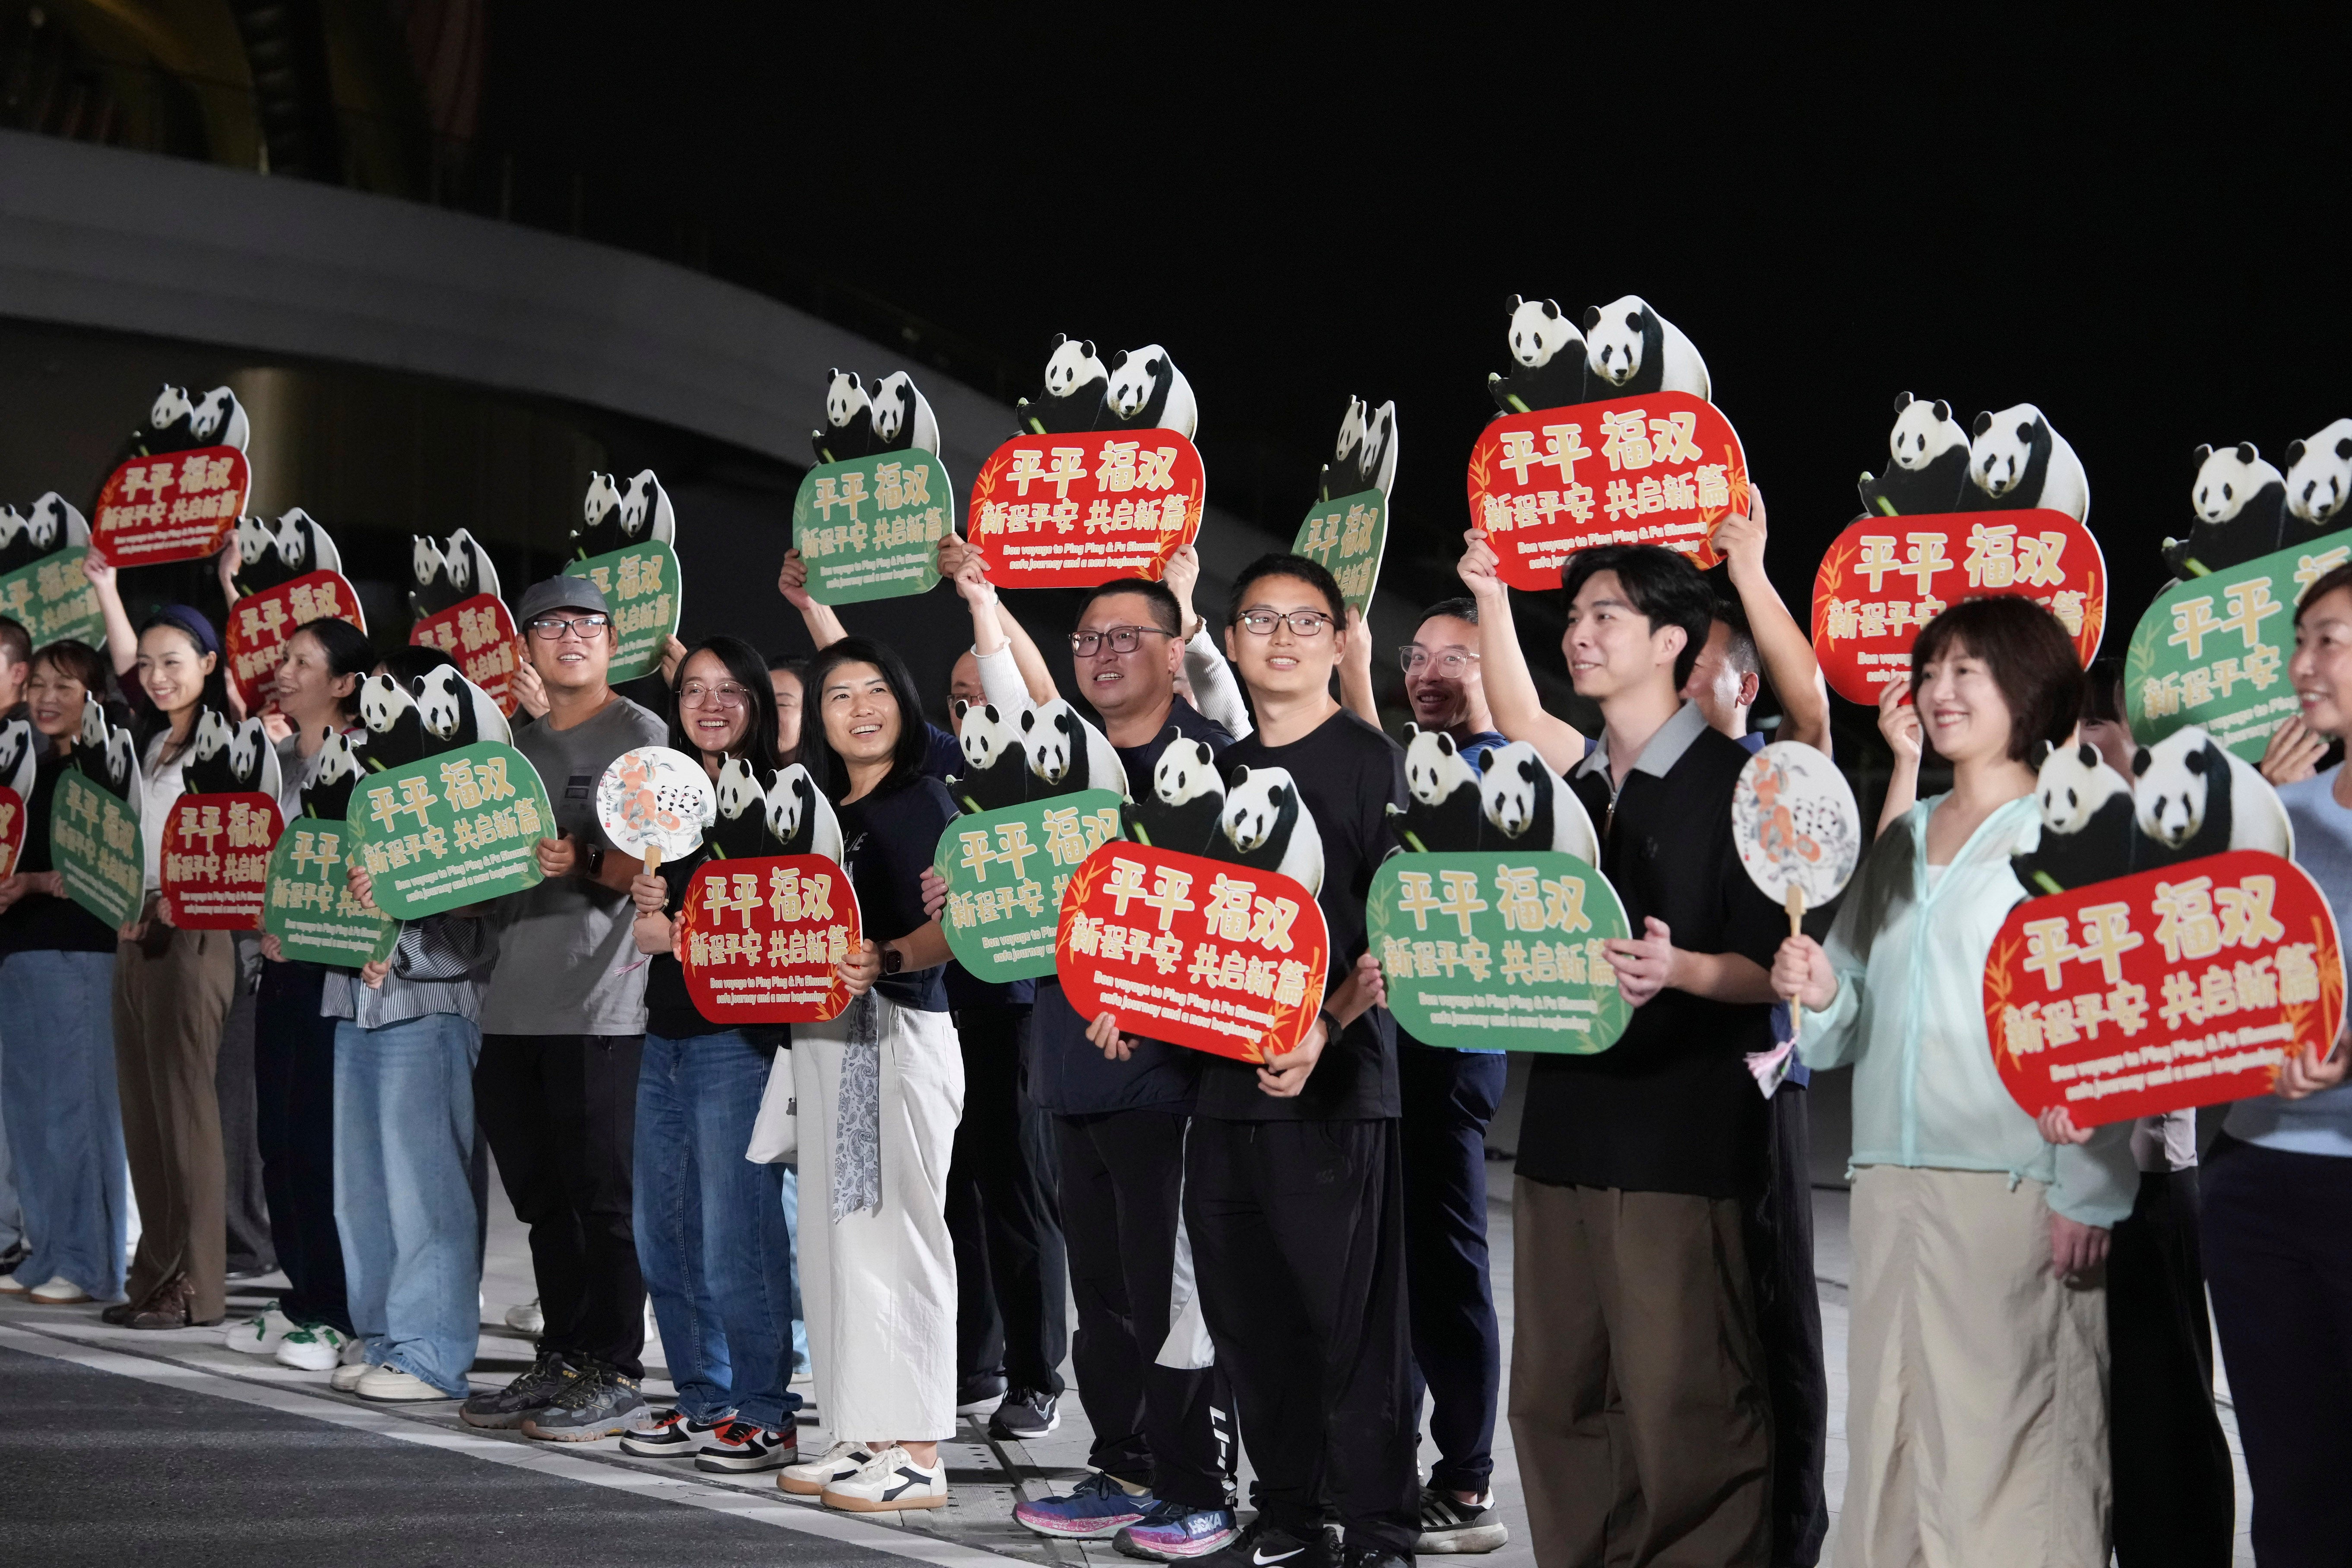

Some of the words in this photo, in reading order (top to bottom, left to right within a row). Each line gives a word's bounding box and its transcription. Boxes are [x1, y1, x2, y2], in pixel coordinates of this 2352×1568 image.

[1006, 447, 1087, 499] 平平
[1095, 440, 1178, 492] 福双
[1499, 423, 1592, 486] 平平
[1600, 409, 1703, 472] 福双
[120, 463, 174, 502] 平平
[813, 472, 869, 521] 平平
[874, 462, 931, 511] 福双
[1483, 481, 1595, 532] 新程平安
[1604, 463, 1729, 522] 共启新篇
[801, 519, 868, 558] 新程平安
[872, 507, 943, 551] 共启新篇
[979, 497, 1079, 535] 新程平安
[1084, 493, 1189, 535] 共启新篇
[1304, 513, 1341, 567] 平平
[1339, 503, 1379, 559] 福双
[1518, 541, 1539, 553] Bon
[1538, 538, 1576, 552] voyage
[1575, 535, 1589, 547] to
[1612, 529, 1639, 543] Ping
[1638, 527, 1649, 540] &
[1648, 526, 1664, 539] Fu
[1663, 522, 1708, 537] Shuang
[1003, 545, 1021, 555] Bon
[1021, 545, 1053, 557] voyage
[1053, 544, 1064, 554] to
[1064, 543, 1084, 556] Ping
[1084, 542, 1105, 555] Ping
[1105, 542, 1114, 552] &
[1114, 542, 1126, 552] Fu
[1126, 541, 1161, 553] Shuang
[1009, 558, 1029, 570] safe
[1028, 558, 1064, 571] journey
[1063, 557, 1081, 568] and
[1080, 559, 1087, 568] a
[1087, 558, 1107, 567] new
[1107, 555, 1151, 569] beginning
[1530, 555, 1553, 568] safe
[1854, 532, 1953, 596] 平平
[1963, 523, 2067, 588] 福双
[616, 554, 663, 602] 福双
[239, 599, 288, 646] 平平
[458, 606, 500, 653] 福双
[2168, 576, 2282, 660] 平平
[1879, 653, 1912, 667] voyag
[2143, 643, 2282, 720] 新程平安
[367, 776, 438, 833] 平平
[440, 756, 516, 813] 福双
[178, 806, 223, 852] 平平
[227, 801, 271, 848] 福双
[362, 824, 448, 875] 新程平安
[453, 797, 541, 854] 共启新篇
[958, 821, 1038, 883] 平平
[290, 830, 341, 881] 平平
[703, 874, 763, 929] 平平
[769, 866, 834, 922] 福双
[948, 877, 1045, 929] 新程平安
[1102, 856, 1195, 931] 平平
[1203, 873, 1299, 953] 福双
[1398, 870, 1488, 937] 平平
[1495, 864, 1592, 934] 福双
[689, 928, 763, 967] 新程平安
[767, 924, 848, 968] 共启新篇
[982, 937, 1000, 949] Bon
[999, 932, 1032, 947] voyage
[1030, 929, 1041, 941] to
[1040, 926, 1057, 938] Pin
[994, 950, 1014, 963] safe
[1012, 945, 1045, 963] journey
[1045, 943, 1055, 954] an
[2023, 902, 2143, 991] 平平
[2152, 875, 2284, 963] 福双
[710, 977, 724, 988] Bon
[723, 979, 747, 990] voyage
[747, 977, 756, 988] to
[755, 976, 772, 990] Ping
[771, 976, 788, 989] Ping
[788, 976, 795, 987] &
[795, 975, 804, 987] Fu
[804, 975, 833, 988] Shuang
[1069, 912, 1183, 975] 新程平安
[1187, 943, 1310, 1007] 共启新篇
[1383, 935, 1492, 982] 新程平安
[1500, 938, 1617, 987] 共启新篇
[716, 992, 731, 1004] safe
[731, 991, 757, 1005] journey
[757, 991, 771, 1003] and
[770, 994, 776, 1003] a
[776, 993, 791, 1003] new
[791, 990, 826, 1005] beginning
[1094, 970, 1114, 987] Bon
[1114, 978, 1151, 997] voyage
[1150, 985, 1163, 998] to
[1162, 987, 1187, 1007] Ping
[1186, 993, 1211, 1013] Ping
[1210, 999, 1220, 1013] &
[1220, 1001, 1235, 1016] Fu
[1235, 1004, 1275, 1028] Shuang
[1100, 992, 1123, 1007] safe
[1121, 995, 1162, 1018] journey
[1161, 1007, 1182, 1021] and
[1181, 1012, 1189, 1023] a
[1189, 1014, 1212, 1028] new
[1211, 1017, 1262, 1043] beginning
[2003, 980, 2149, 1055] 新程平安
[2159, 944, 2319, 1030] 共启新篇
[1188, 1513, 1222, 1535] HOKA
